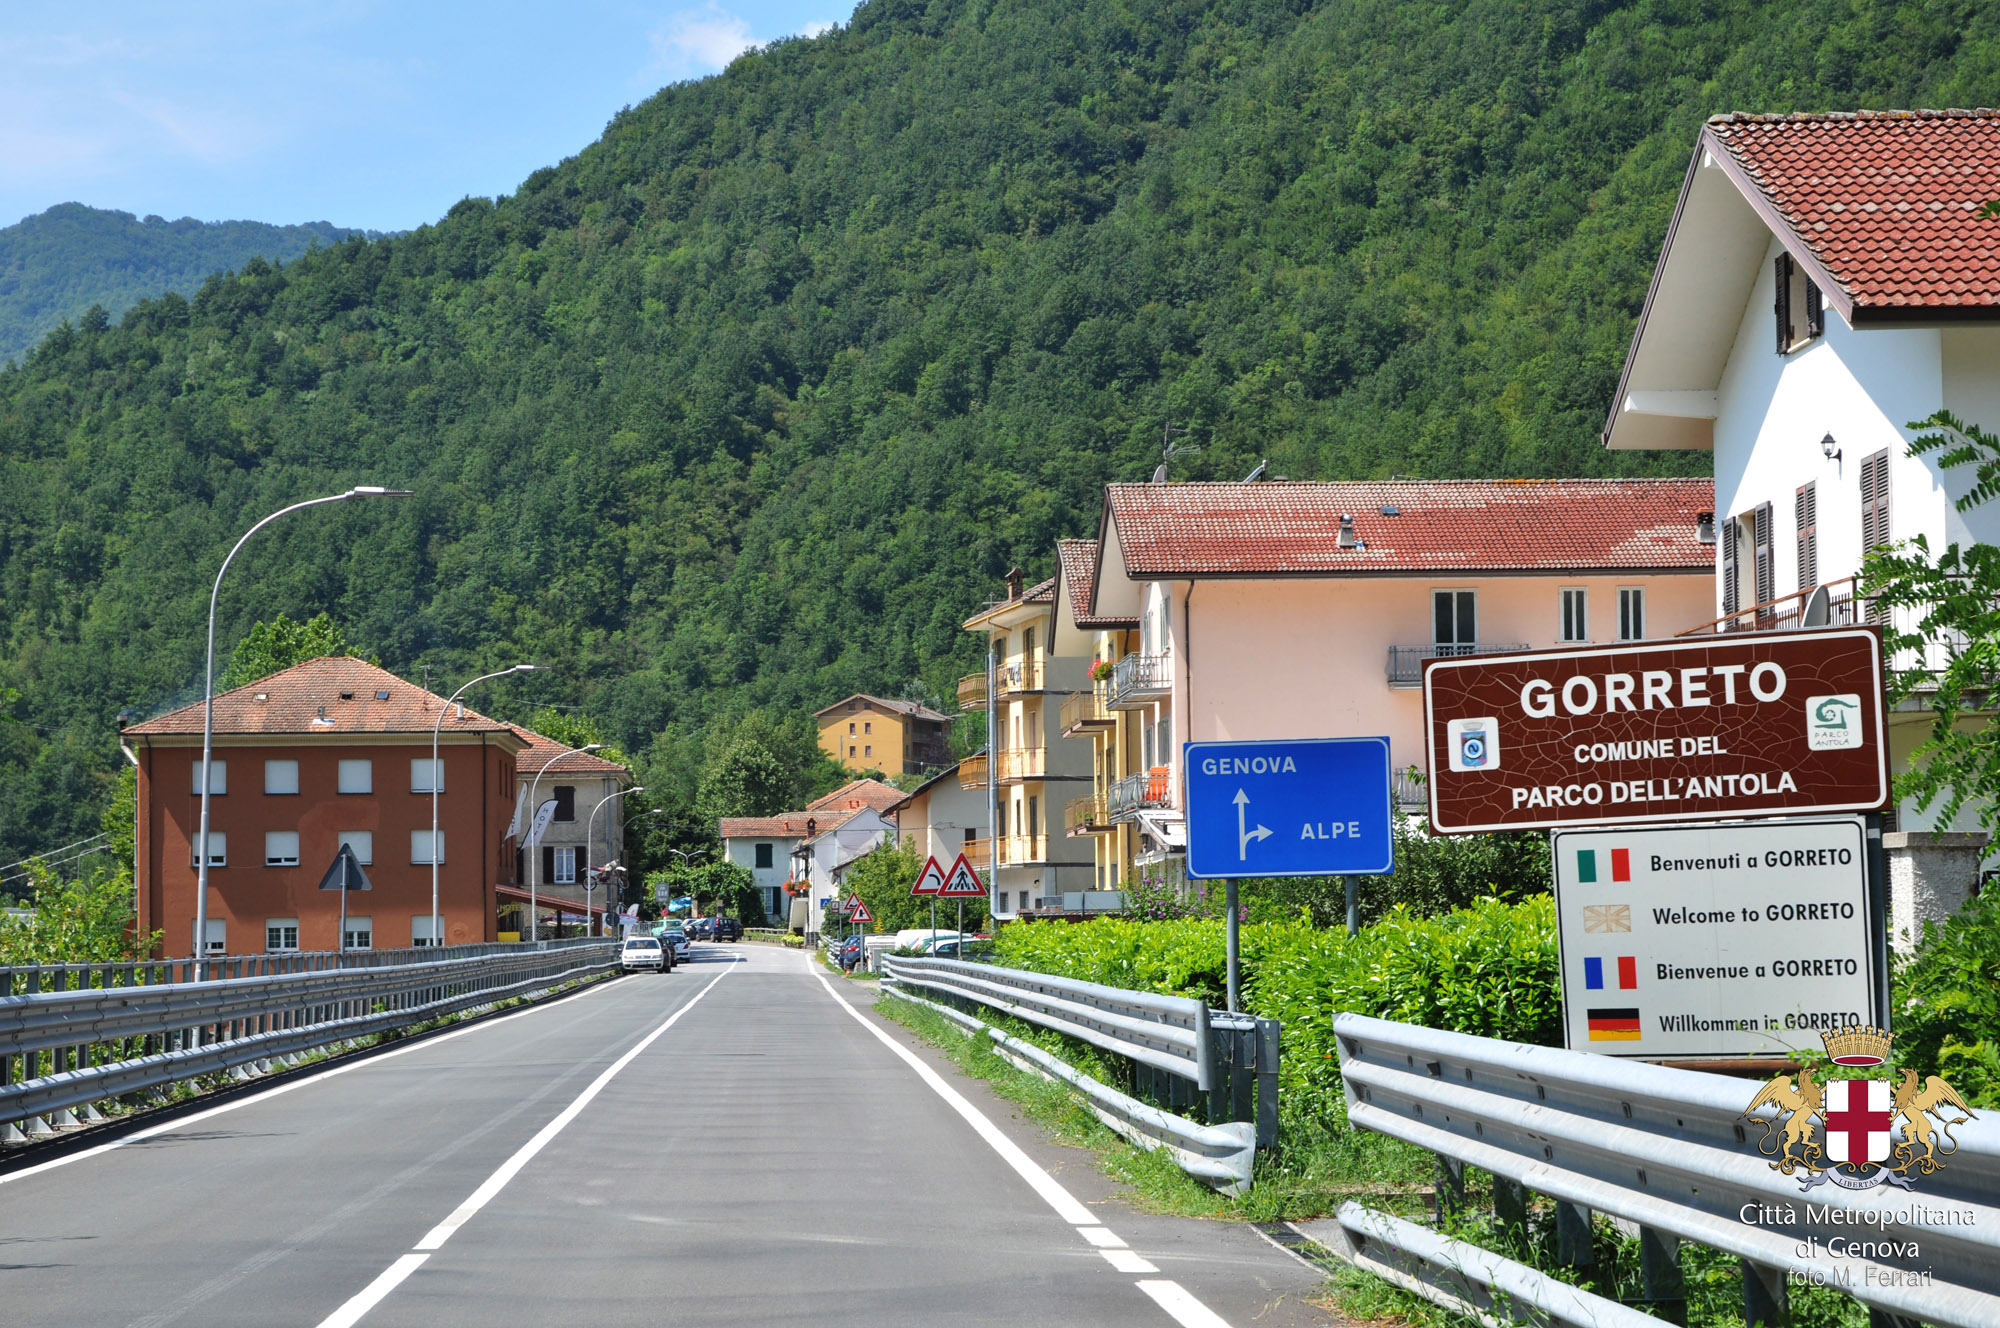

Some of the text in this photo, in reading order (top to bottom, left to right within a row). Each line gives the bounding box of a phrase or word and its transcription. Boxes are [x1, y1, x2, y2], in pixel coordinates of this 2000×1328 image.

[1520, 661, 1787, 718] GORRETO
[1574, 736, 1727, 763] COMUNE DEL
[1815, 739, 1849, 747] ANTOLA
[1202, 756, 1297, 775] GENOVA
[1512, 771, 1797, 809] PARCO DELL'ANTOLA
[1301, 821, 1361, 840] ALPE
[1651, 848, 1852, 871] Benvenuti a GORRETO
[1653, 902, 1854, 924] Welcome to GORRETO
[1657, 959, 1858, 980] Bienvenue a GORRETO
[1659, 1012, 1861, 1032] Willkommen in GORRETO
